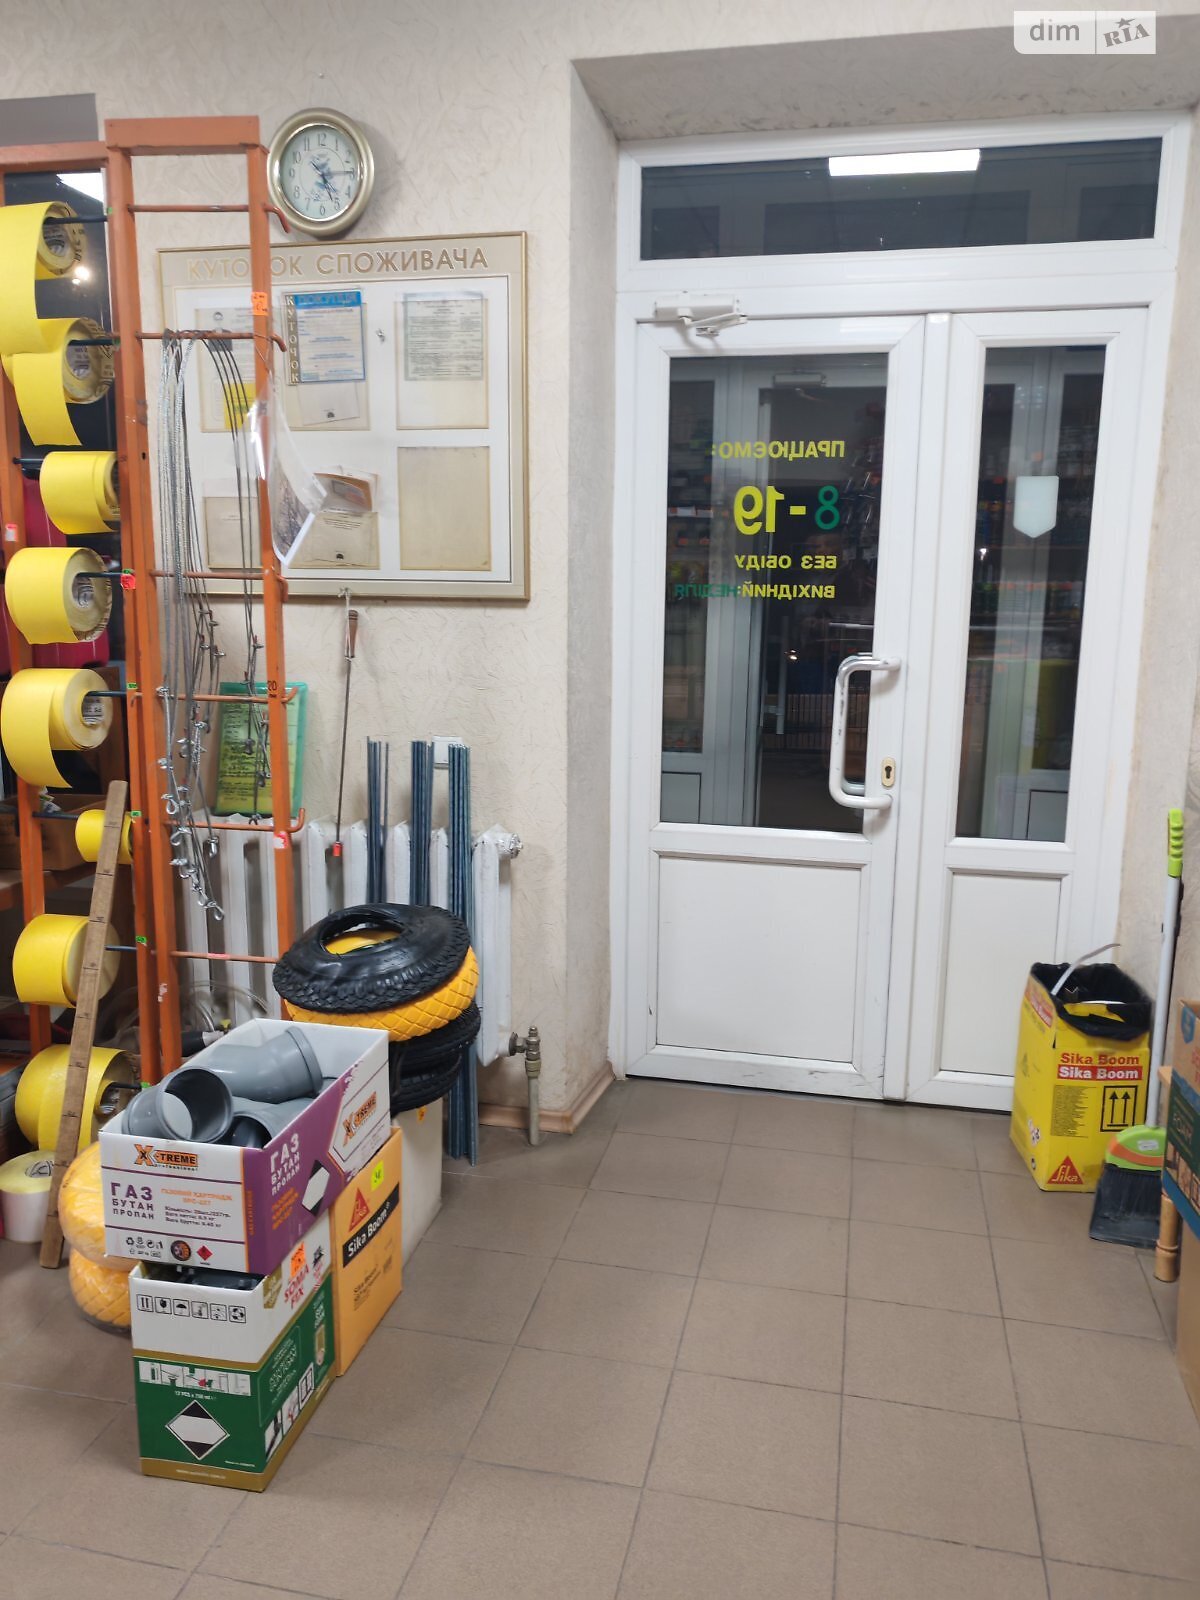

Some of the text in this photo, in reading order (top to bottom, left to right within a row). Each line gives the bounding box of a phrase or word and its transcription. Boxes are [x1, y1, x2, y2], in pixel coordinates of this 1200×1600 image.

[187, 247, 489, 279] КУТООК СПОЖИВАЧА
[1060, 1052, 1140, 1066] Sika Boom
[1058, 1066, 1139, 1080] Sika Boom
[270, 1132, 299, 1174] ГАЗ
[271, 1154, 300, 1185] БУТАН
[1051, 1164, 1078, 1183] Sika
[271, 1164, 300, 1197] ПРОПАН
[110, 1181, 153, 1202] ГАЗ
[111, 1198, 154, 1212] БУТАН
[112, 1208, 155, 1220] ПРОПАН
[347, 1232, 367, 1258] Sika
